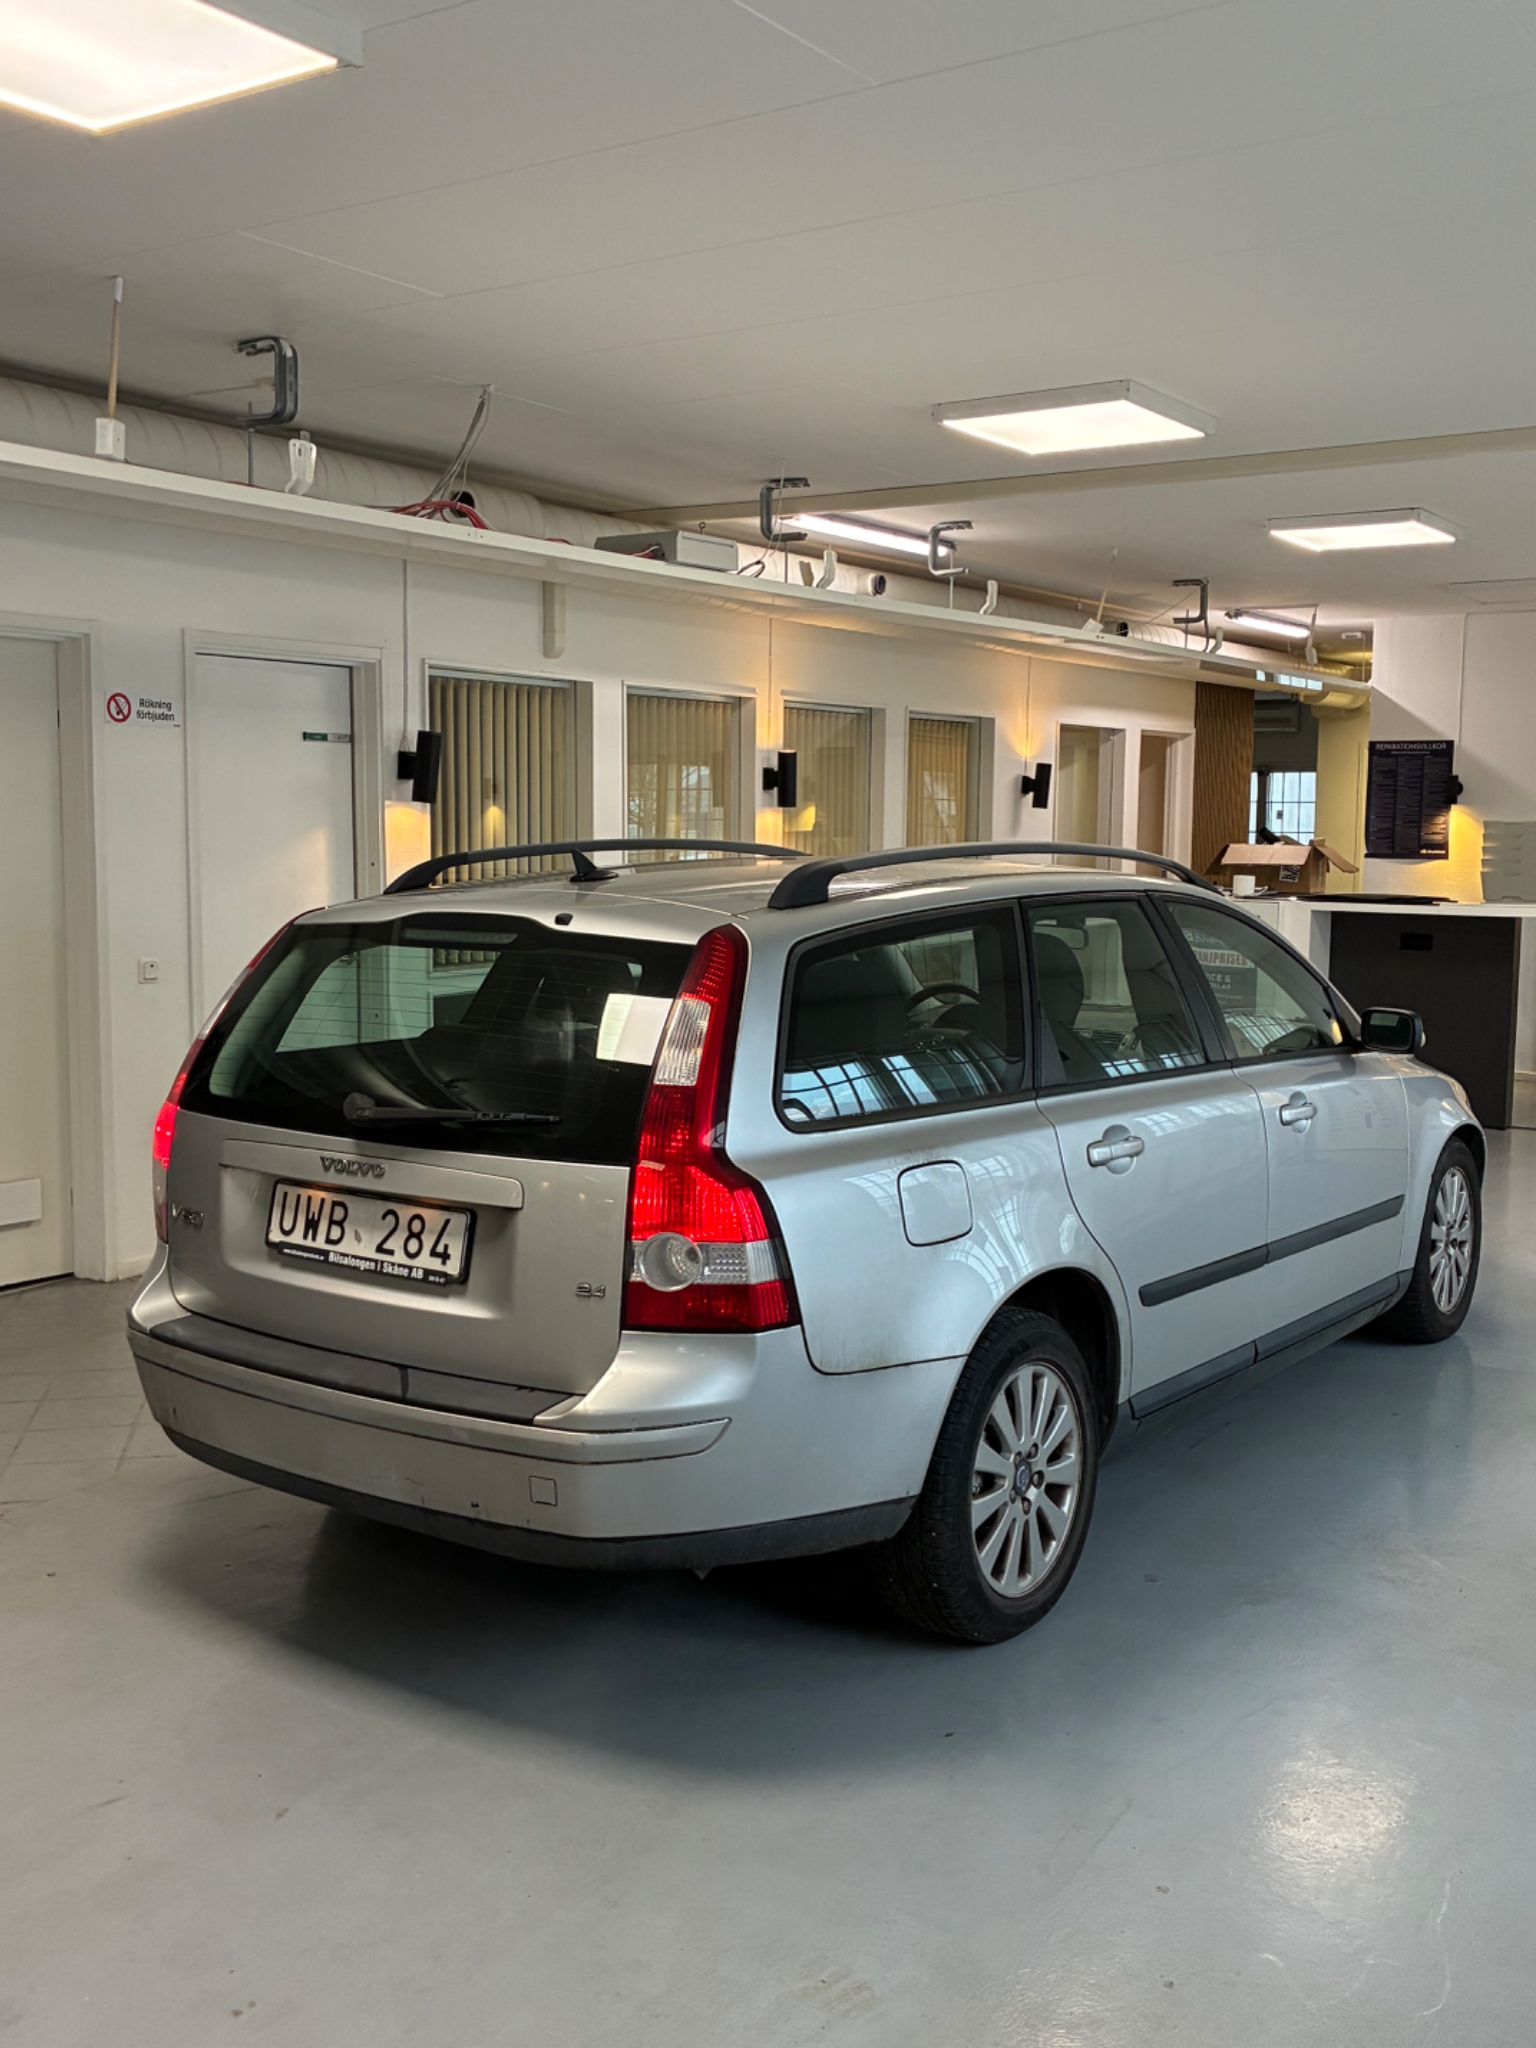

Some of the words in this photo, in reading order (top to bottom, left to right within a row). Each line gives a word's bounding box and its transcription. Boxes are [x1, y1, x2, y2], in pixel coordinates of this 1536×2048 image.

[136, 710, 175, 723] förbjuden
[139, 698, 172, 712] Rökning
[319, 1156, 386, 1179] VOLVO
[279, 1191, 349, 1246] UWB
[375, 1208, 452, 1266] 284
[328, 1251, 376, 1271] Bilsalongen
[382, 1261, 409, 1277] Skåne
[410, 1267, 424, 1279] AB
